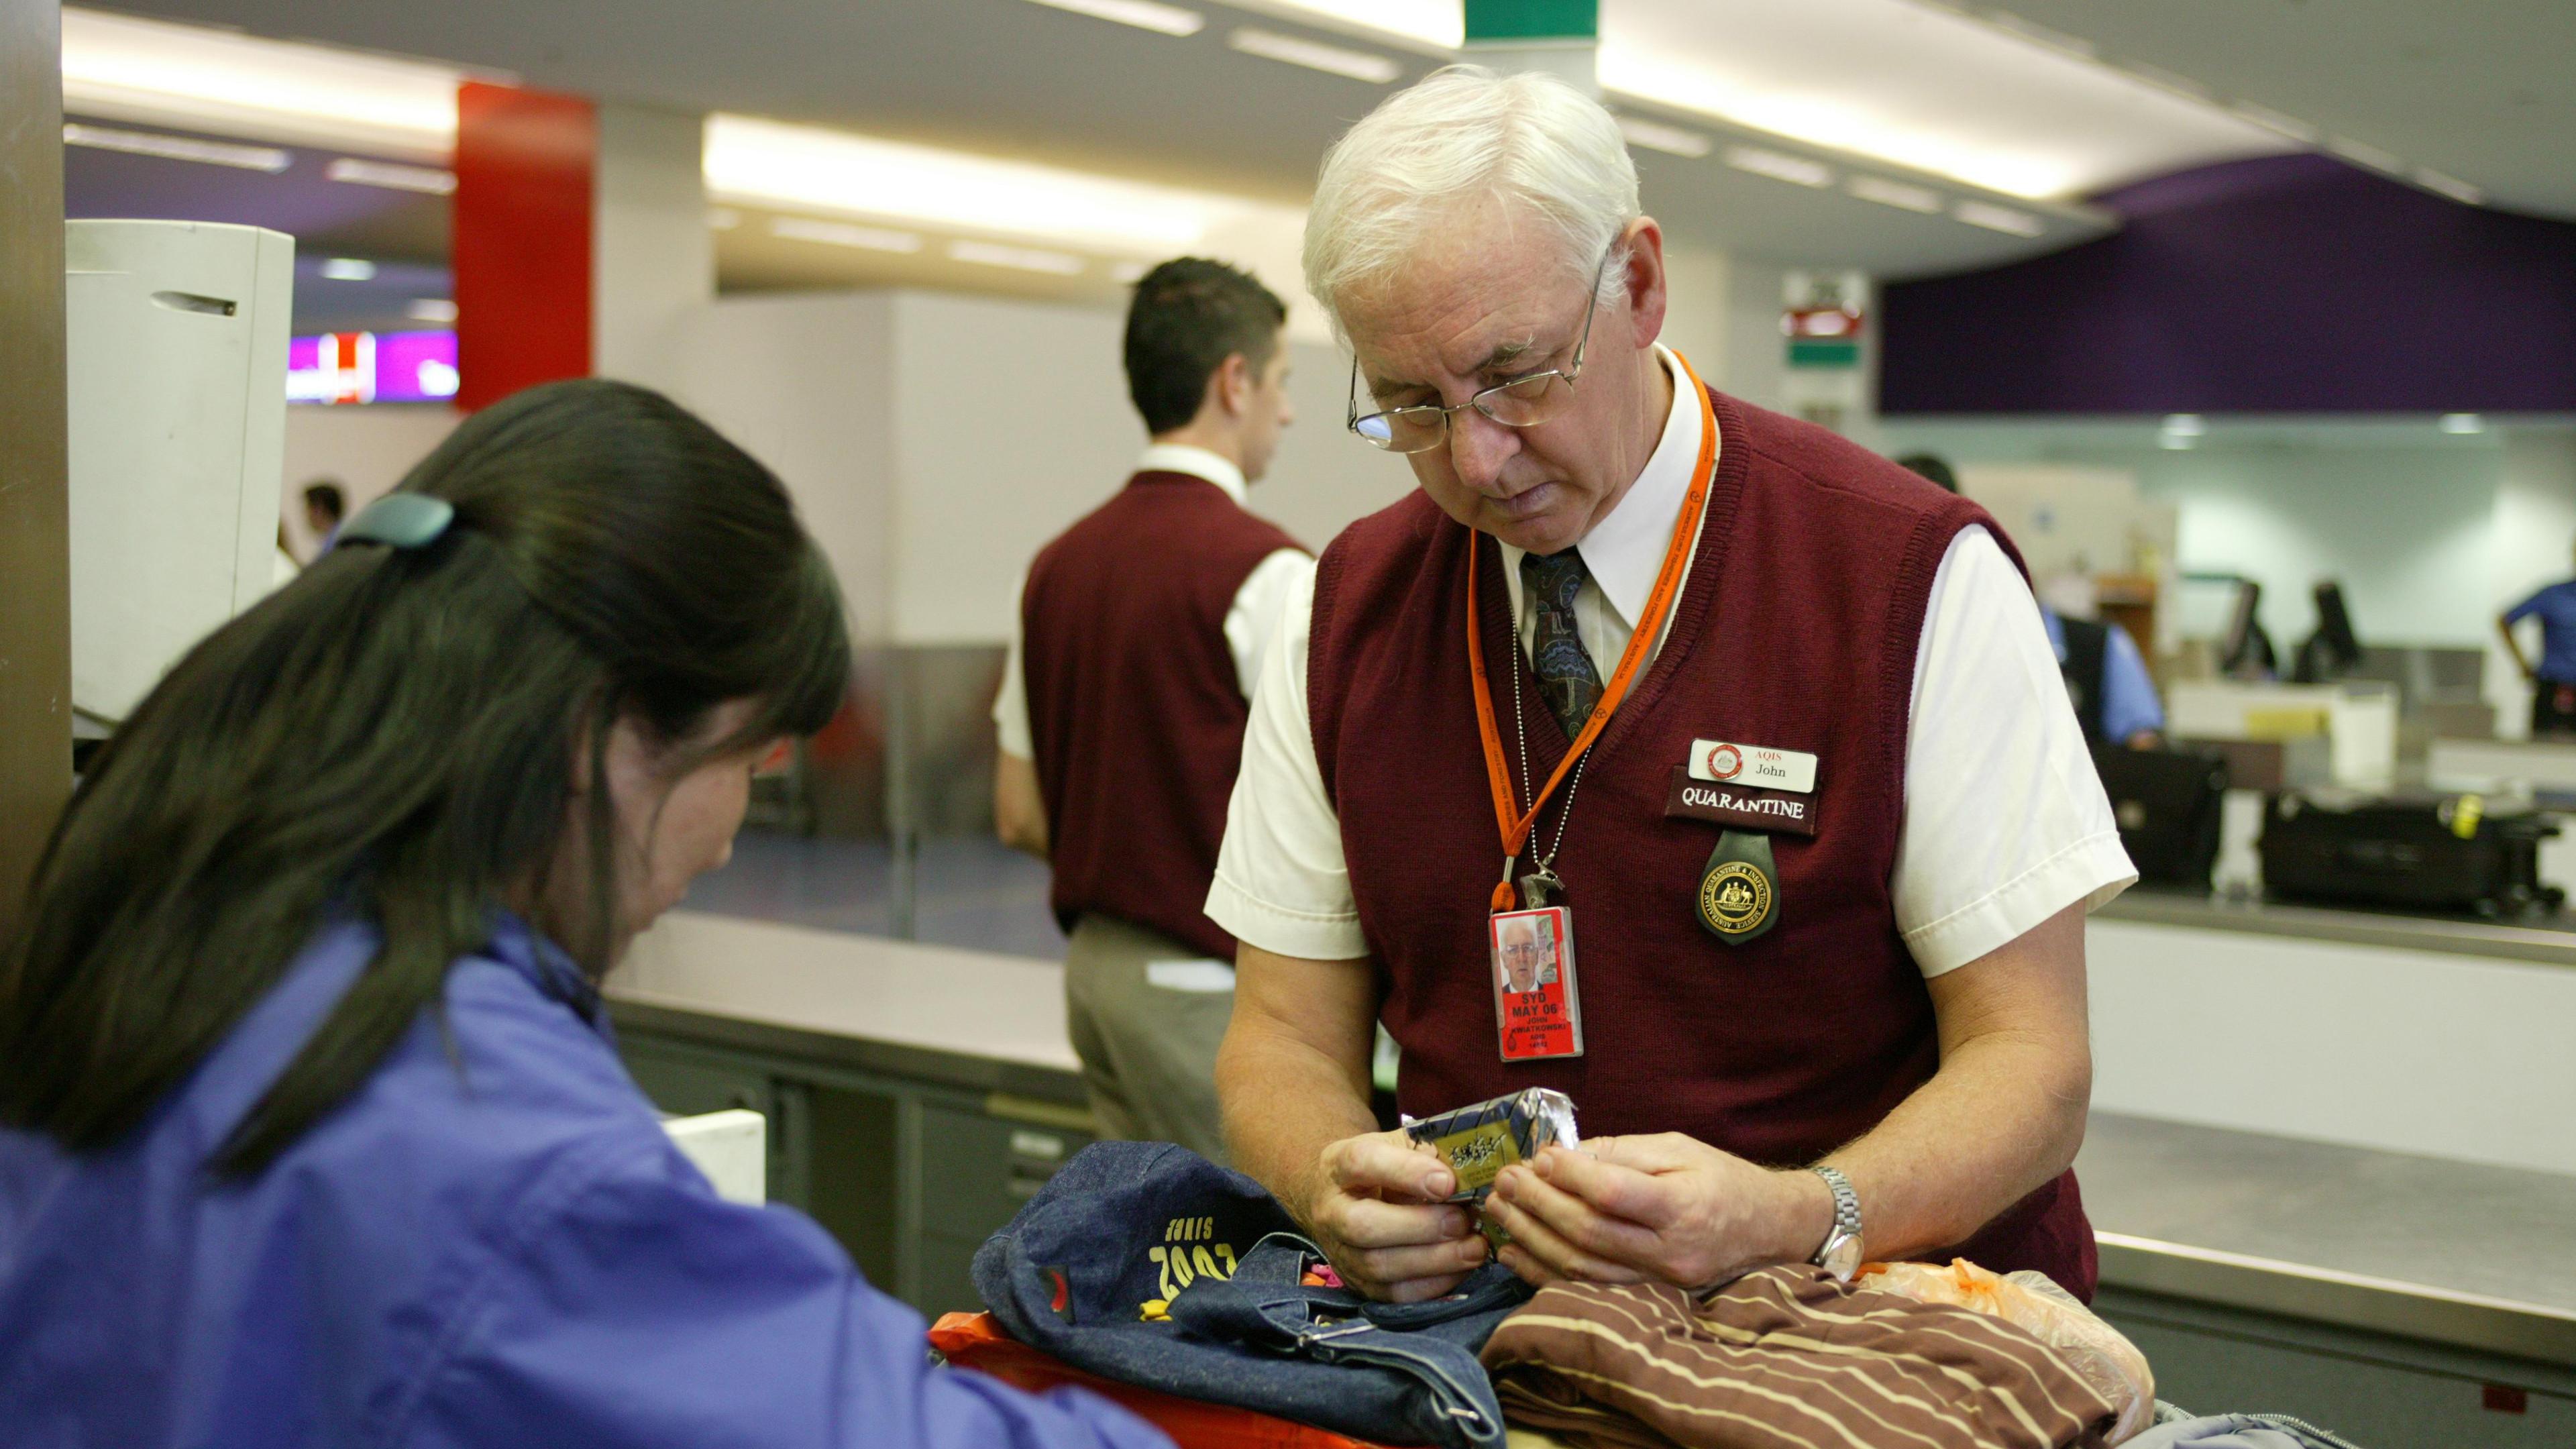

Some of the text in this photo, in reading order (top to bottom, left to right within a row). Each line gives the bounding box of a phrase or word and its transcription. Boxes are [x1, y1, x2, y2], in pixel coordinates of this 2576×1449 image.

[1656, 588, 1665, 602] AND
[1642, 602, 1660, 638] FORESTRY
[1617, 643, 1641, 680] AUSTRALIA
[1755, 750, 1782, 761] AQIS
[1756, 763, 1786, 778] John
[1682, 787, 1804, 820] QUARANTINE
[1705, 865, 1741, 893] QUARANTINE
[1748, 870, 1766, 910] INSPECTION
[1705, 895, 1732, 928] AUSTRALIAN
[1735, 910, 1762, 929] SERVICE
[1521, 993, 1546, 1004] SYD
[1513, 1004, 1558, 1018] MAY 06
[1527, 1016, 1548, 1024] JOHN
